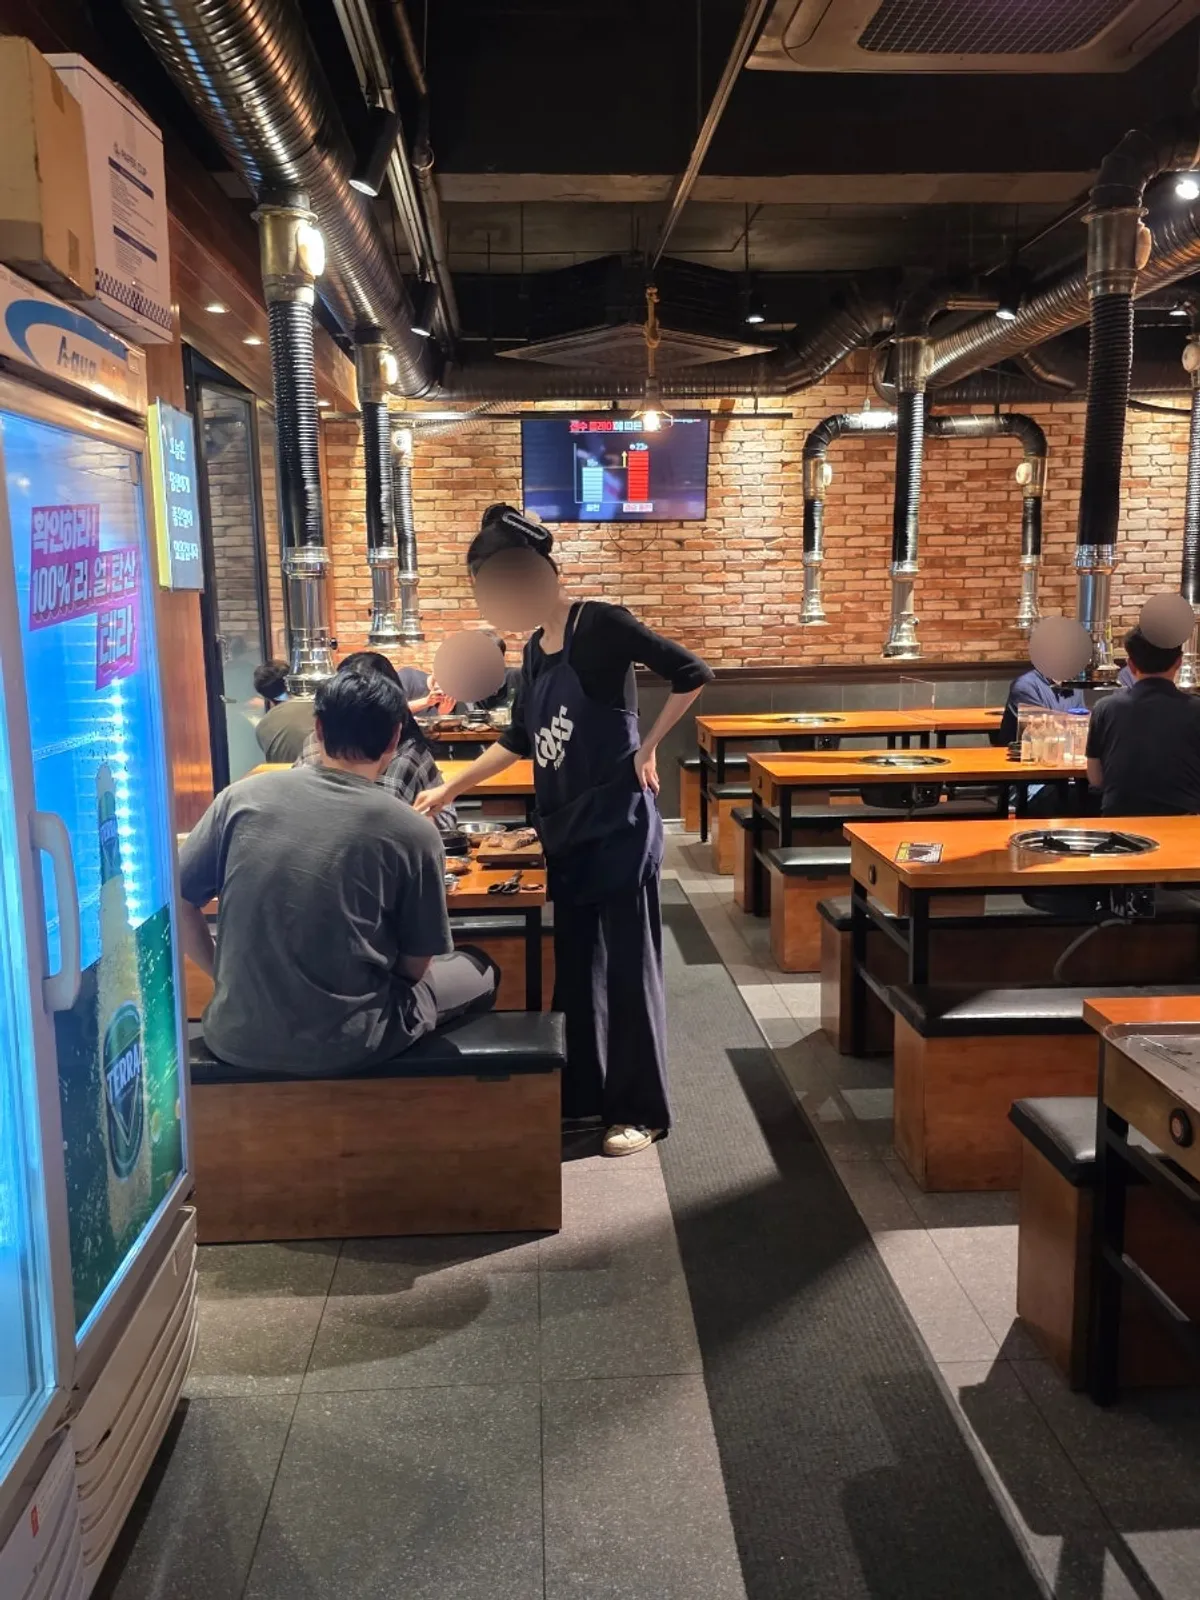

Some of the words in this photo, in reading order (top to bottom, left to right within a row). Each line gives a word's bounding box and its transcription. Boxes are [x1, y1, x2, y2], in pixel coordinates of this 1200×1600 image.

[57, 335, 97, 381] Aqua
[33, 509, 97, 555] 확인하라!
[33, 562, 71, 614] 100%
[100, 605, 134, 665] 테라
[107, 1043, 140, 1104] TERRA
